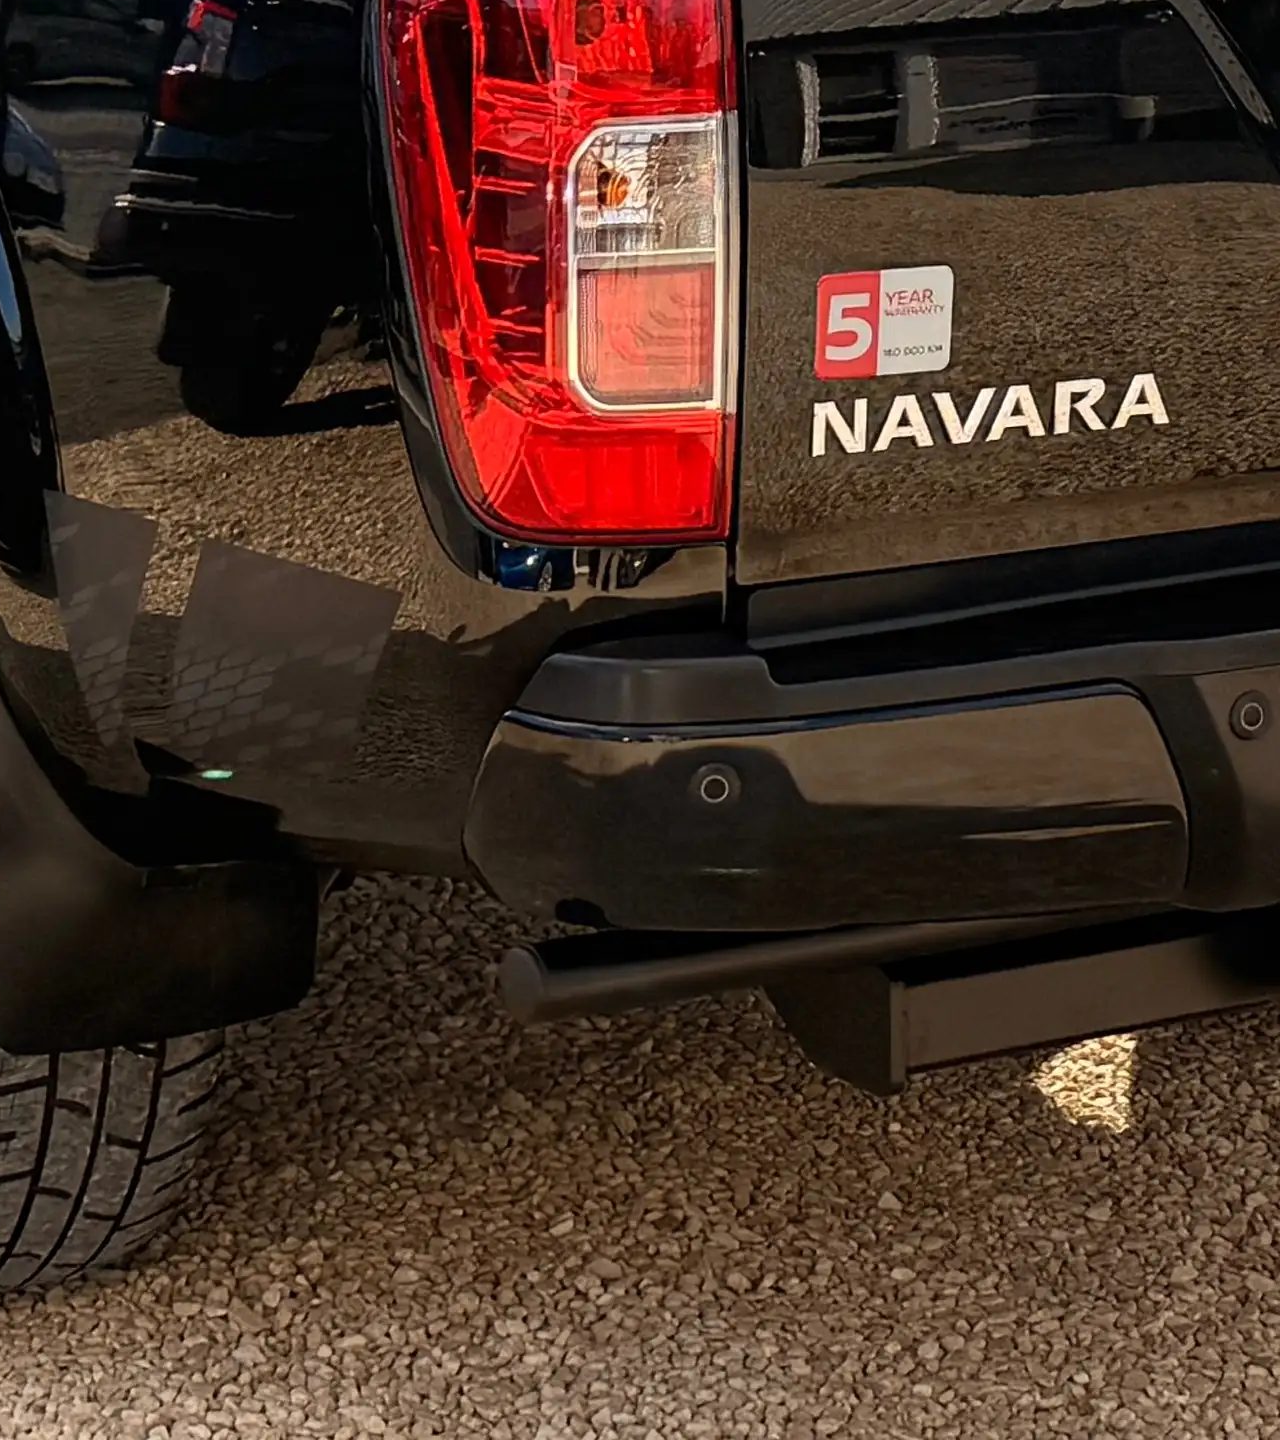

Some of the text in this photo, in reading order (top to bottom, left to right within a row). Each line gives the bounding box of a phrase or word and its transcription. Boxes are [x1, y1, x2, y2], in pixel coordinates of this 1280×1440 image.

[824, 288, 933, 361] 5 YEAR
[812, 373, 1170, 457] NAVARA
